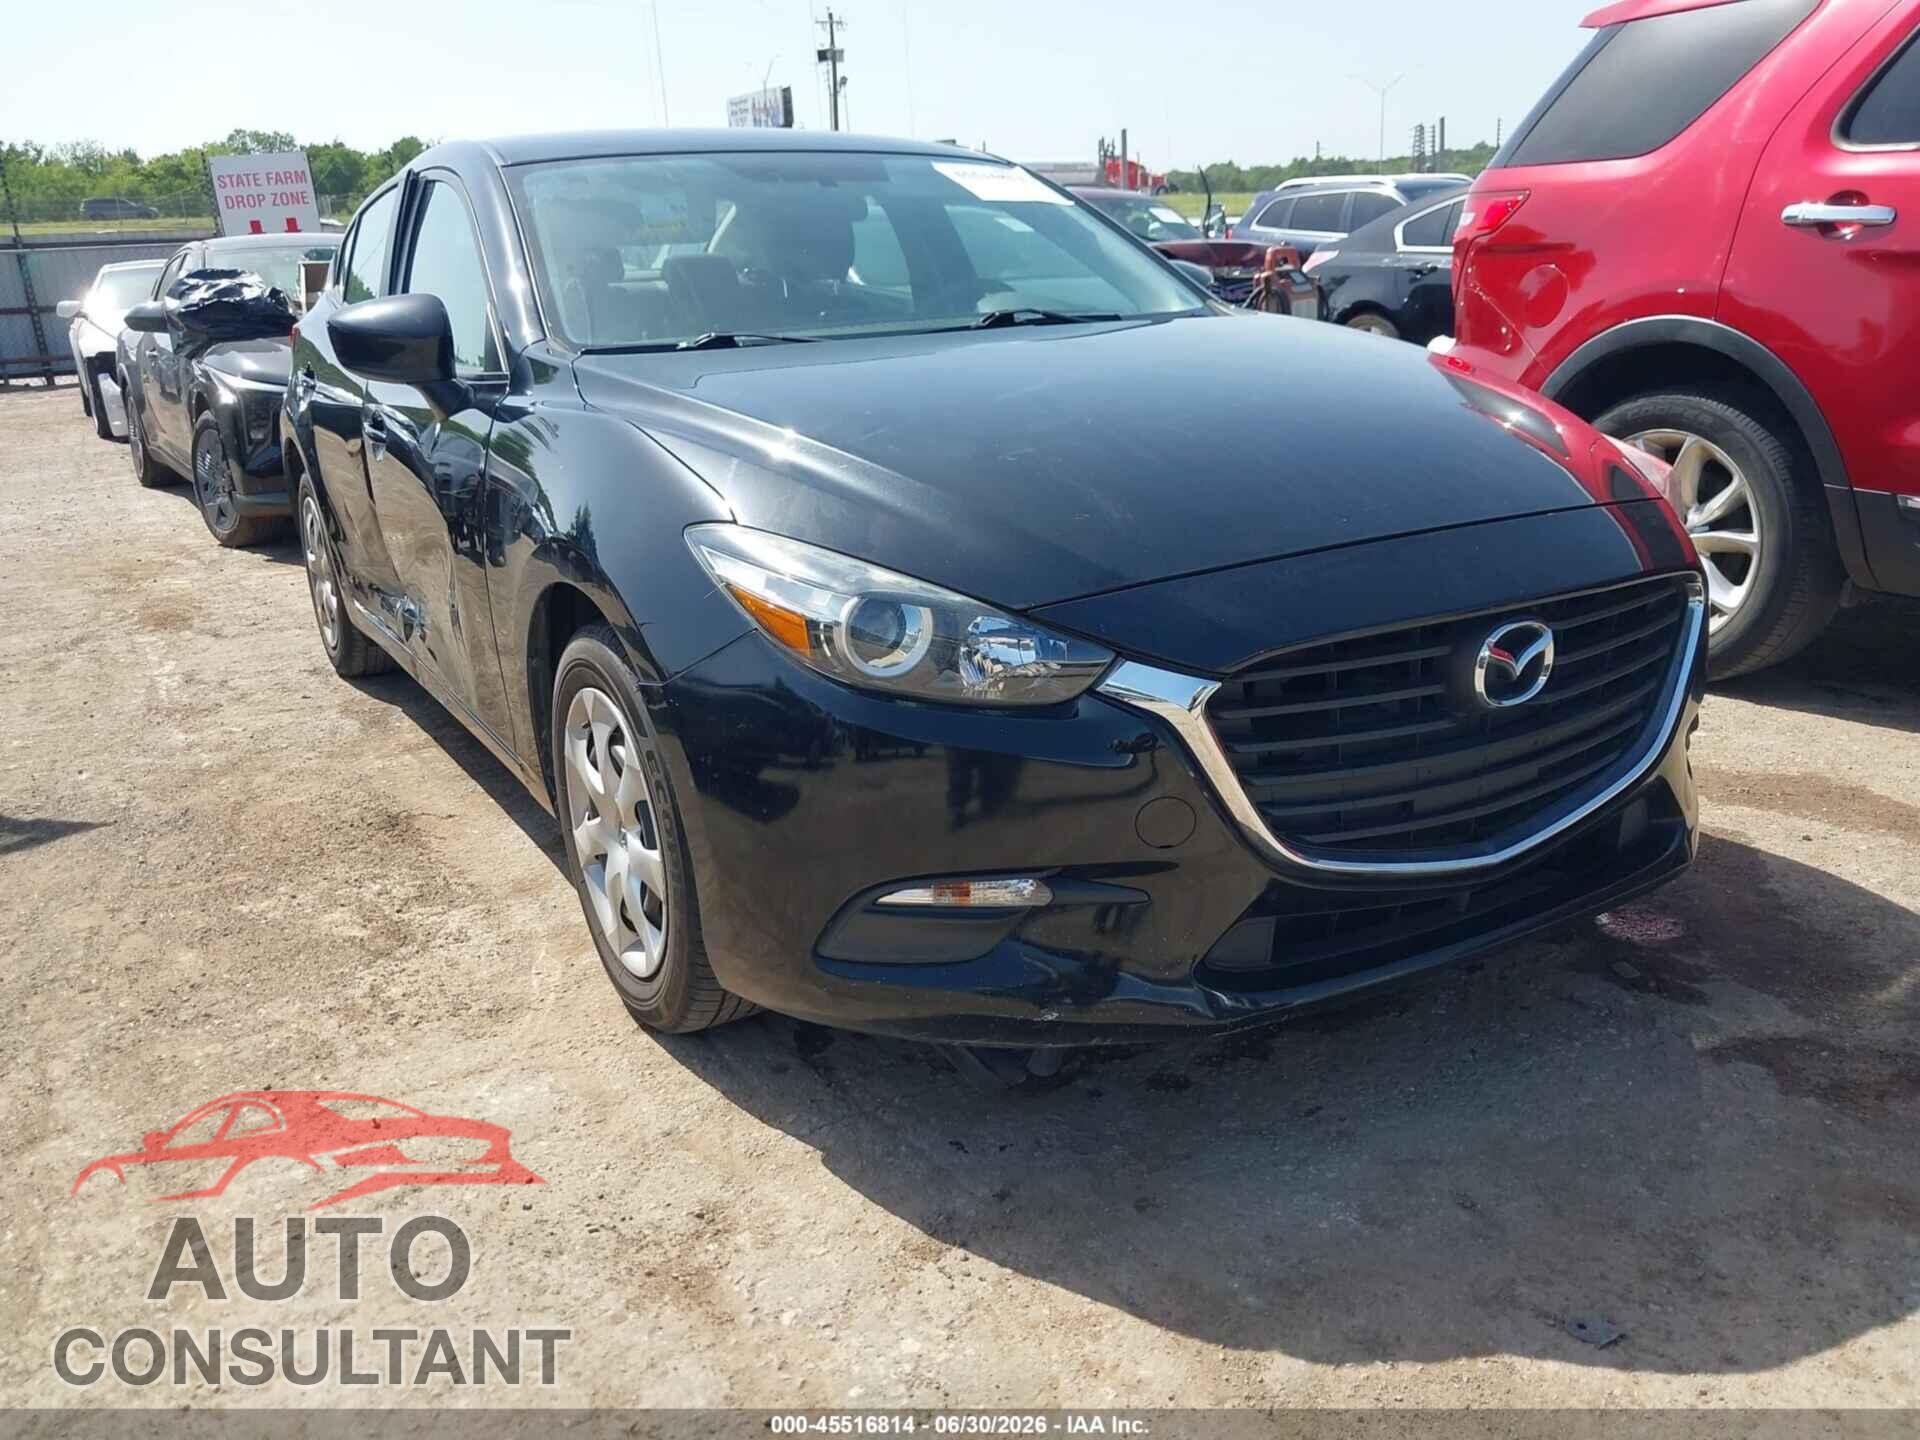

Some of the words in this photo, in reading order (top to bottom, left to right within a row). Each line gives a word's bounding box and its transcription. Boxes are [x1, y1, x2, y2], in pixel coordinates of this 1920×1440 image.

[217, 172, 262, 189] STATE
[265, 170, 307, 185] FARM
[224, 193, 266, 210] DROP
[270, 191, 310, 207] ZONE
